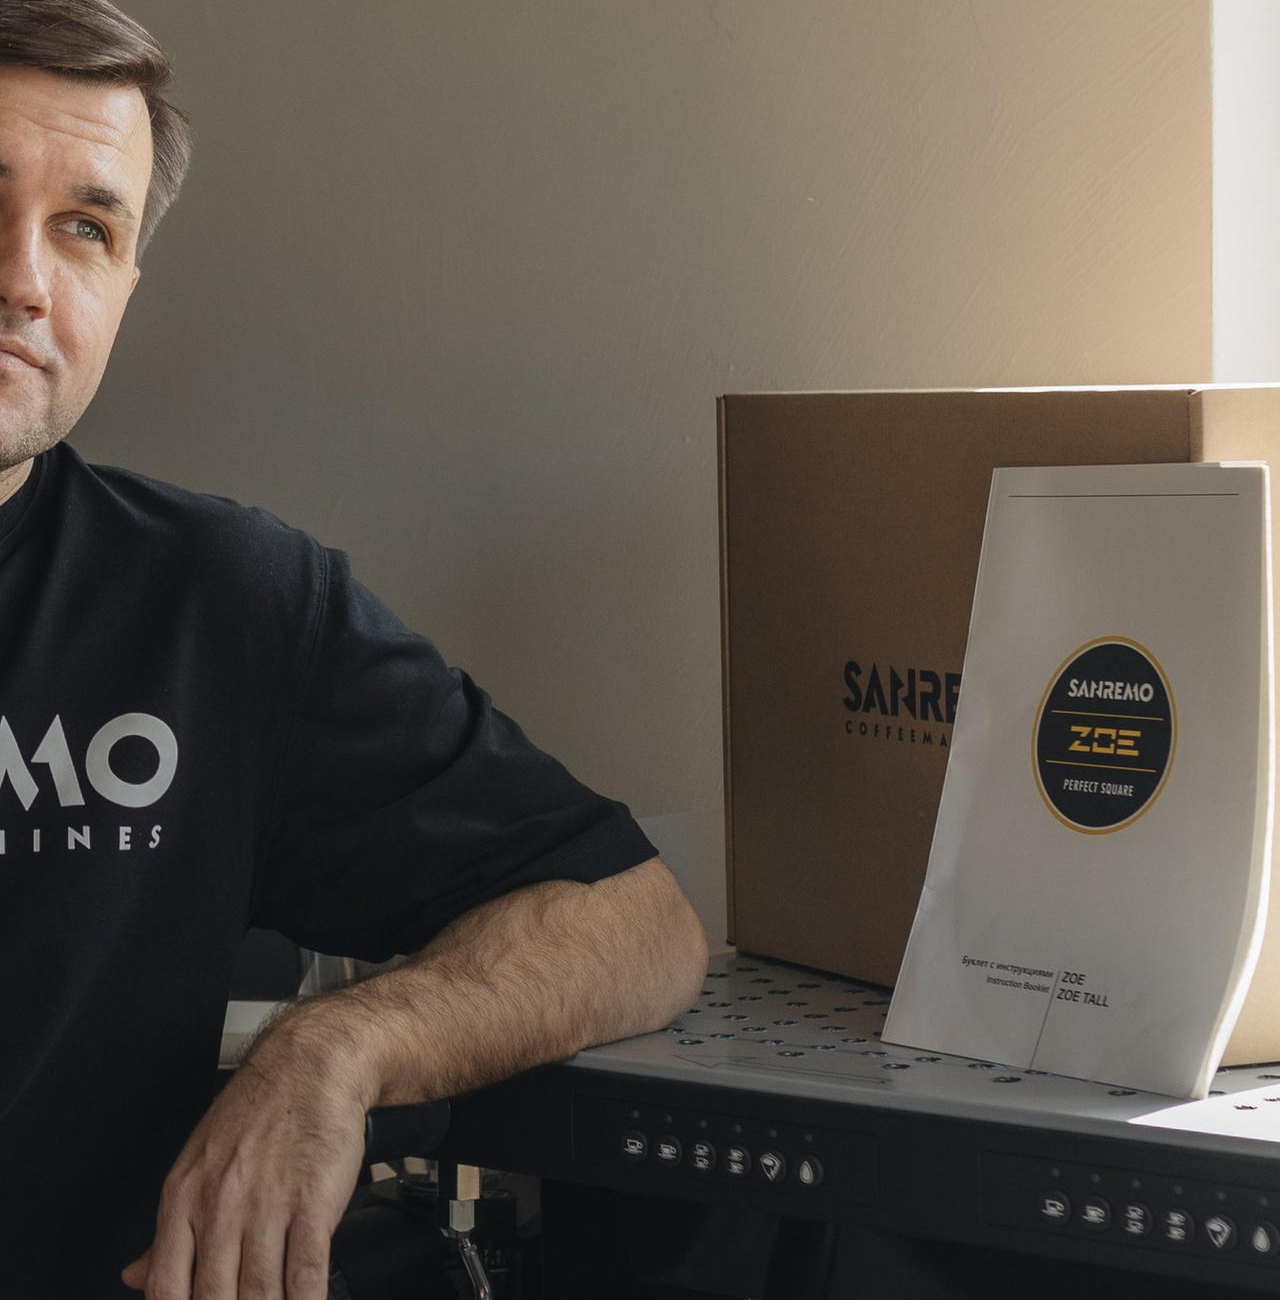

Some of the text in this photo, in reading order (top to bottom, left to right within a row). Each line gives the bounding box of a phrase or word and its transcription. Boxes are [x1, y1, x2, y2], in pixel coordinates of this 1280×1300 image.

[1067, 678, 1155, 703] SANREMO
[844, 720, 949, 748] COFFEEMA
[1067, 725, 1142, 757] ZOE
[1063, 778, 1135, 797] PERFECT SQUARE
[962, 955, 989, 967] Буклет
[997, 964, 1054, 978] инструкциями
[987, 976, 1050, 993] Instruction Booklet
[1061, 971, 1086, 986] ZOE
[1056, 988, 1109, 1008] ZOE TALL
